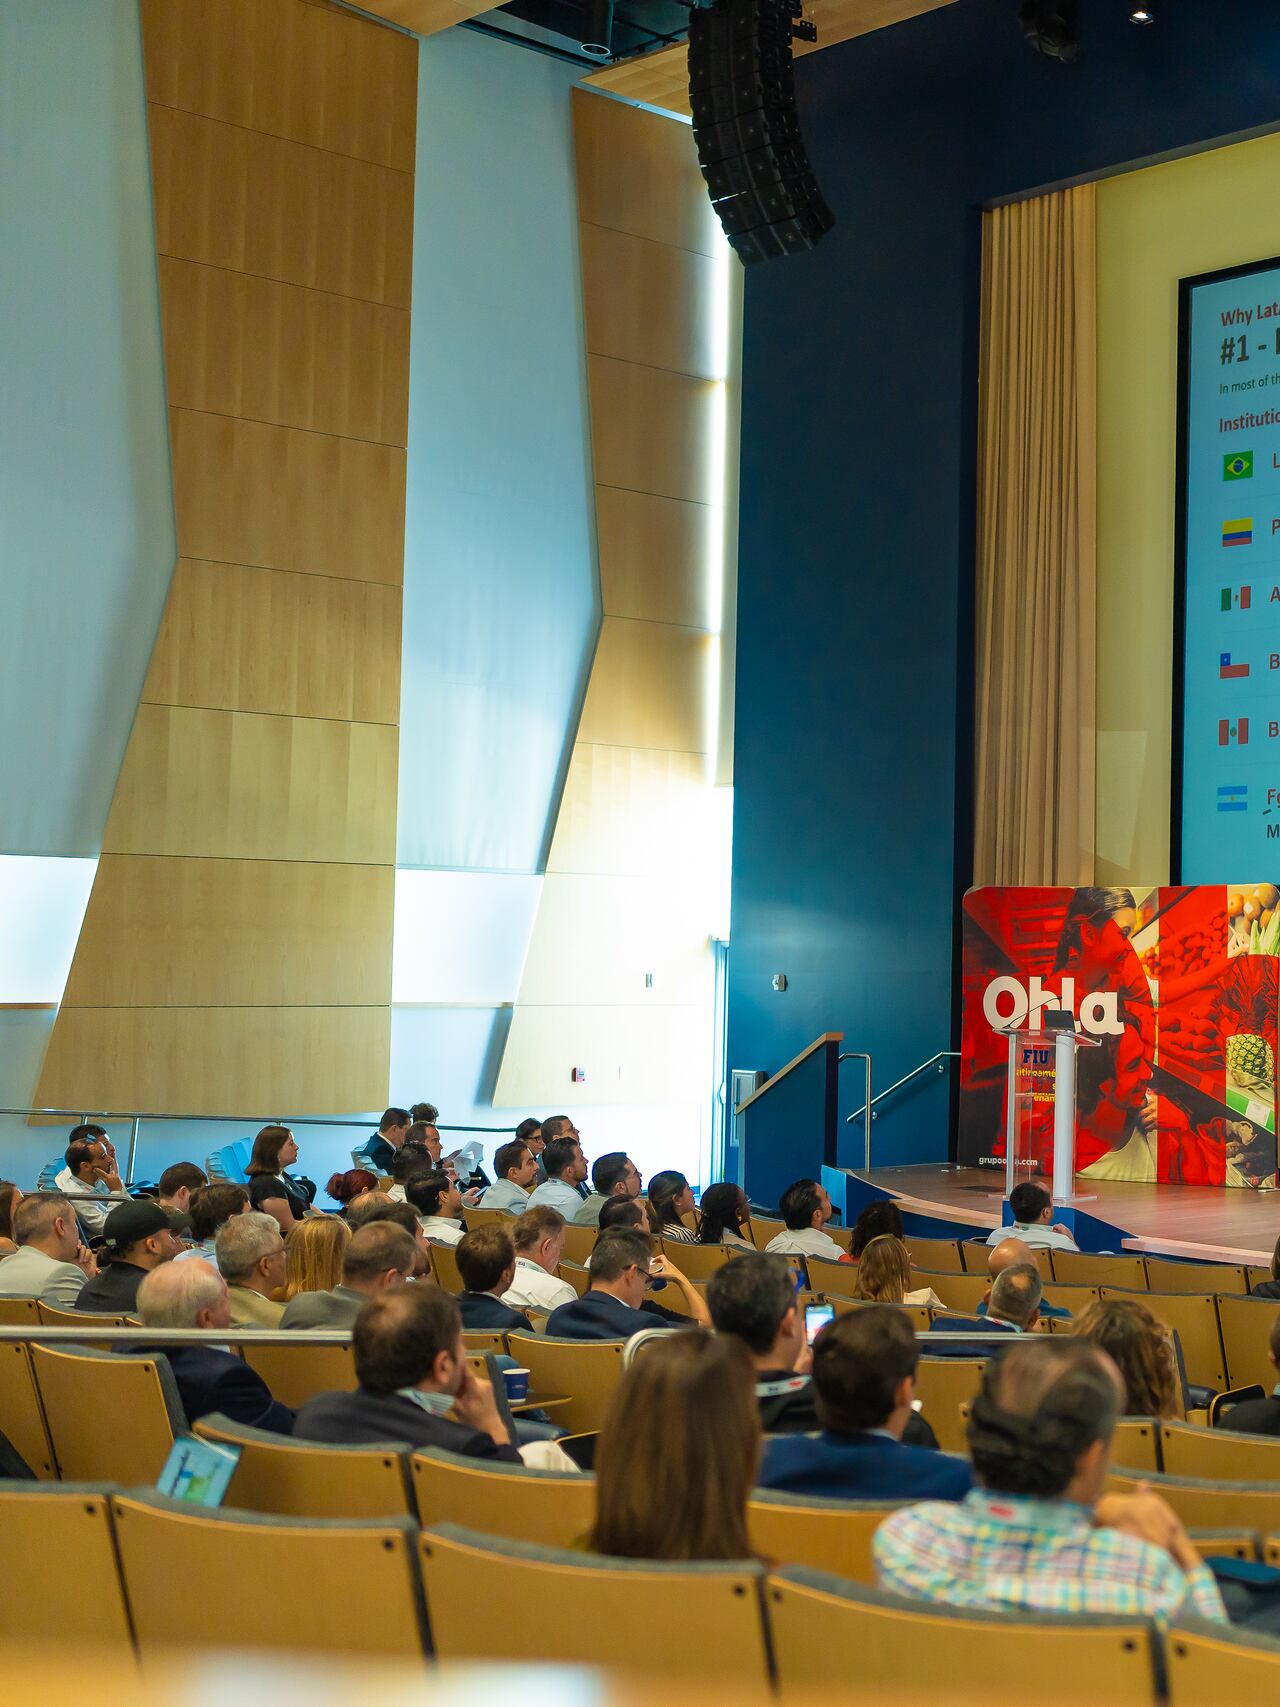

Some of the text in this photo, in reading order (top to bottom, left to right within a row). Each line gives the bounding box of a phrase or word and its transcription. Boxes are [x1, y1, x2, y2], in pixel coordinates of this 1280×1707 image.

[1221, 309, 1252, 326] Why
[1220, 335, 1249, 365] #1
[1220, 384, 1228, 394] In
[1232, 380, 1255, 392] most
[1258, 375, 1268, 387] of
[1024, 1050, 1048, 1064] FIU
